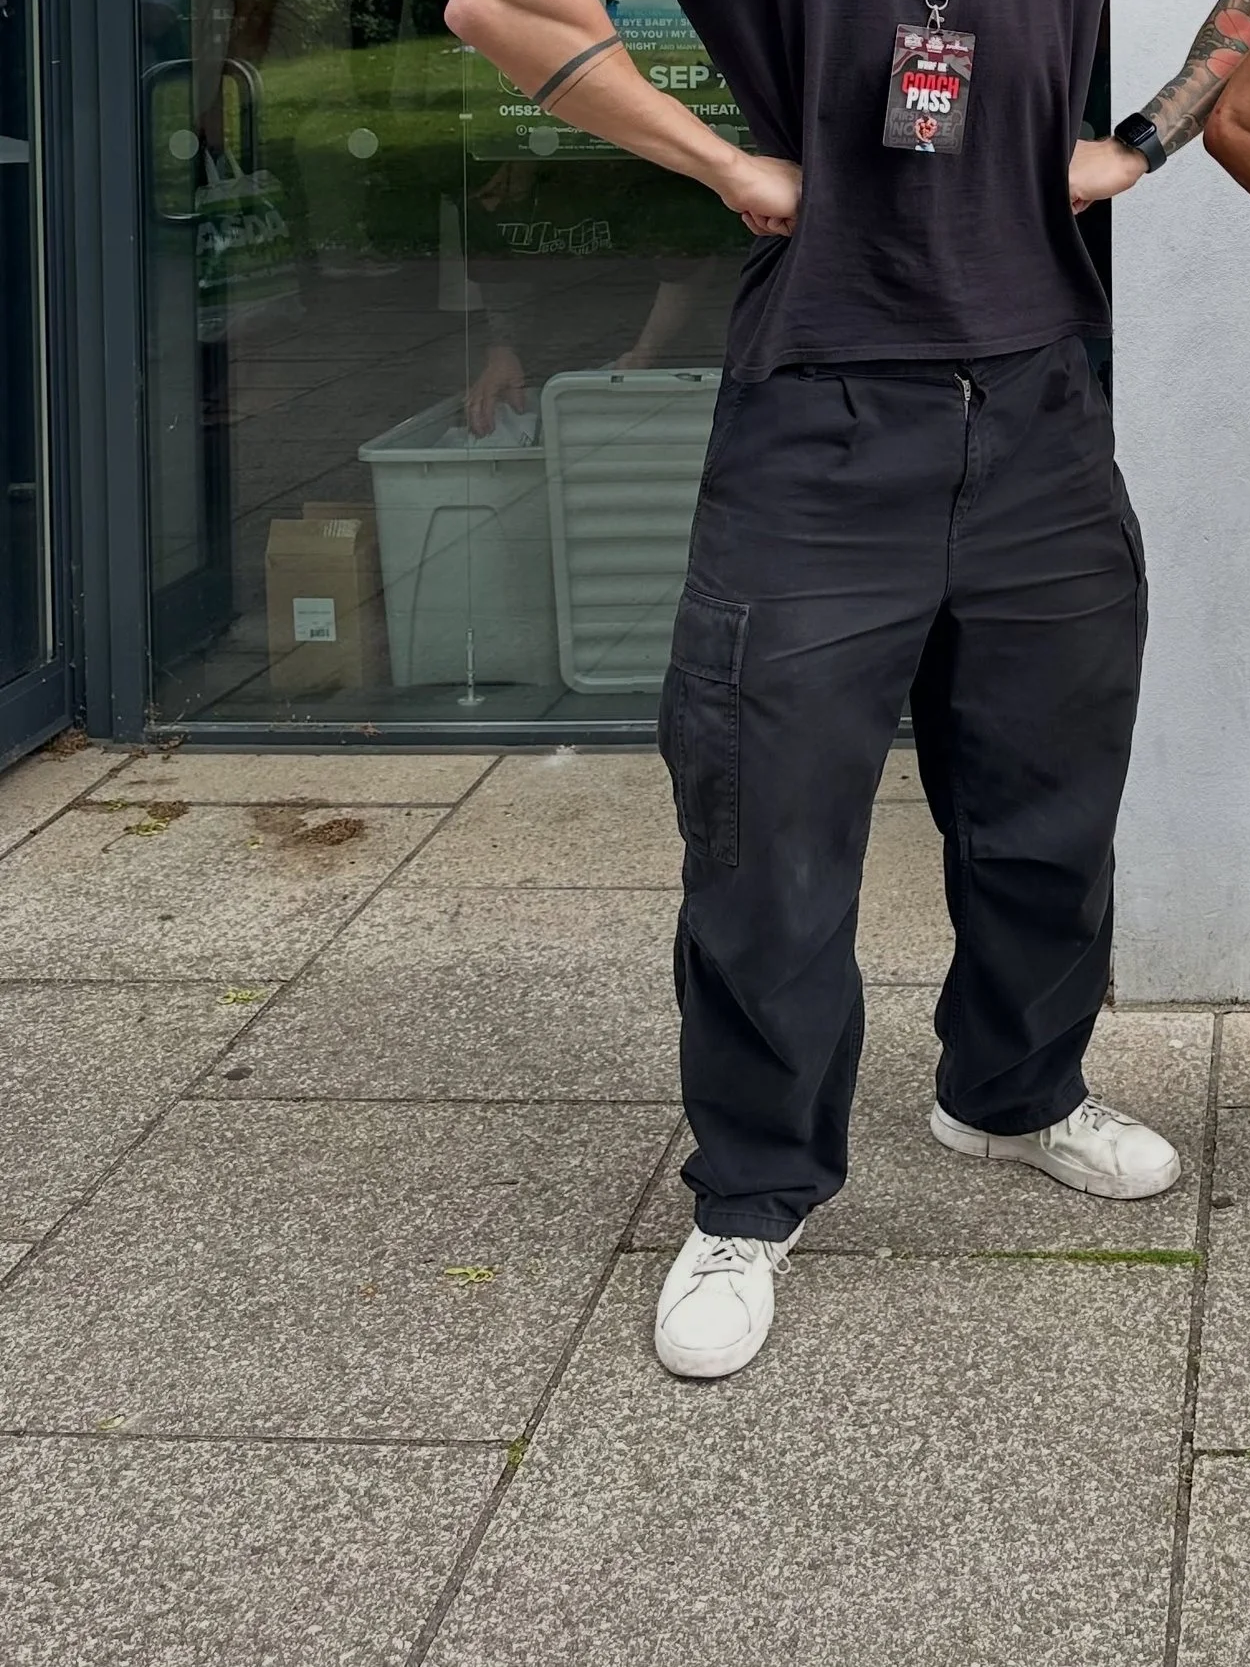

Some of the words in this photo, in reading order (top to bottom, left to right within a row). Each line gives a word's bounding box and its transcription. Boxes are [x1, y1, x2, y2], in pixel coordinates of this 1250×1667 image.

[622, 18, 643, 27] BYE
[645, 18, 673, 27] BABY
[625, 30, 640, 39] TO
[641, 30, 663, 39] YOU
[671, 30, 687, 39] MY
[650, 65, 709, 89] SEP
[902, 72, 960, 100] COACH
[906, 86, 952, 114] PASS
[500, 104, 541, 116] 01582
